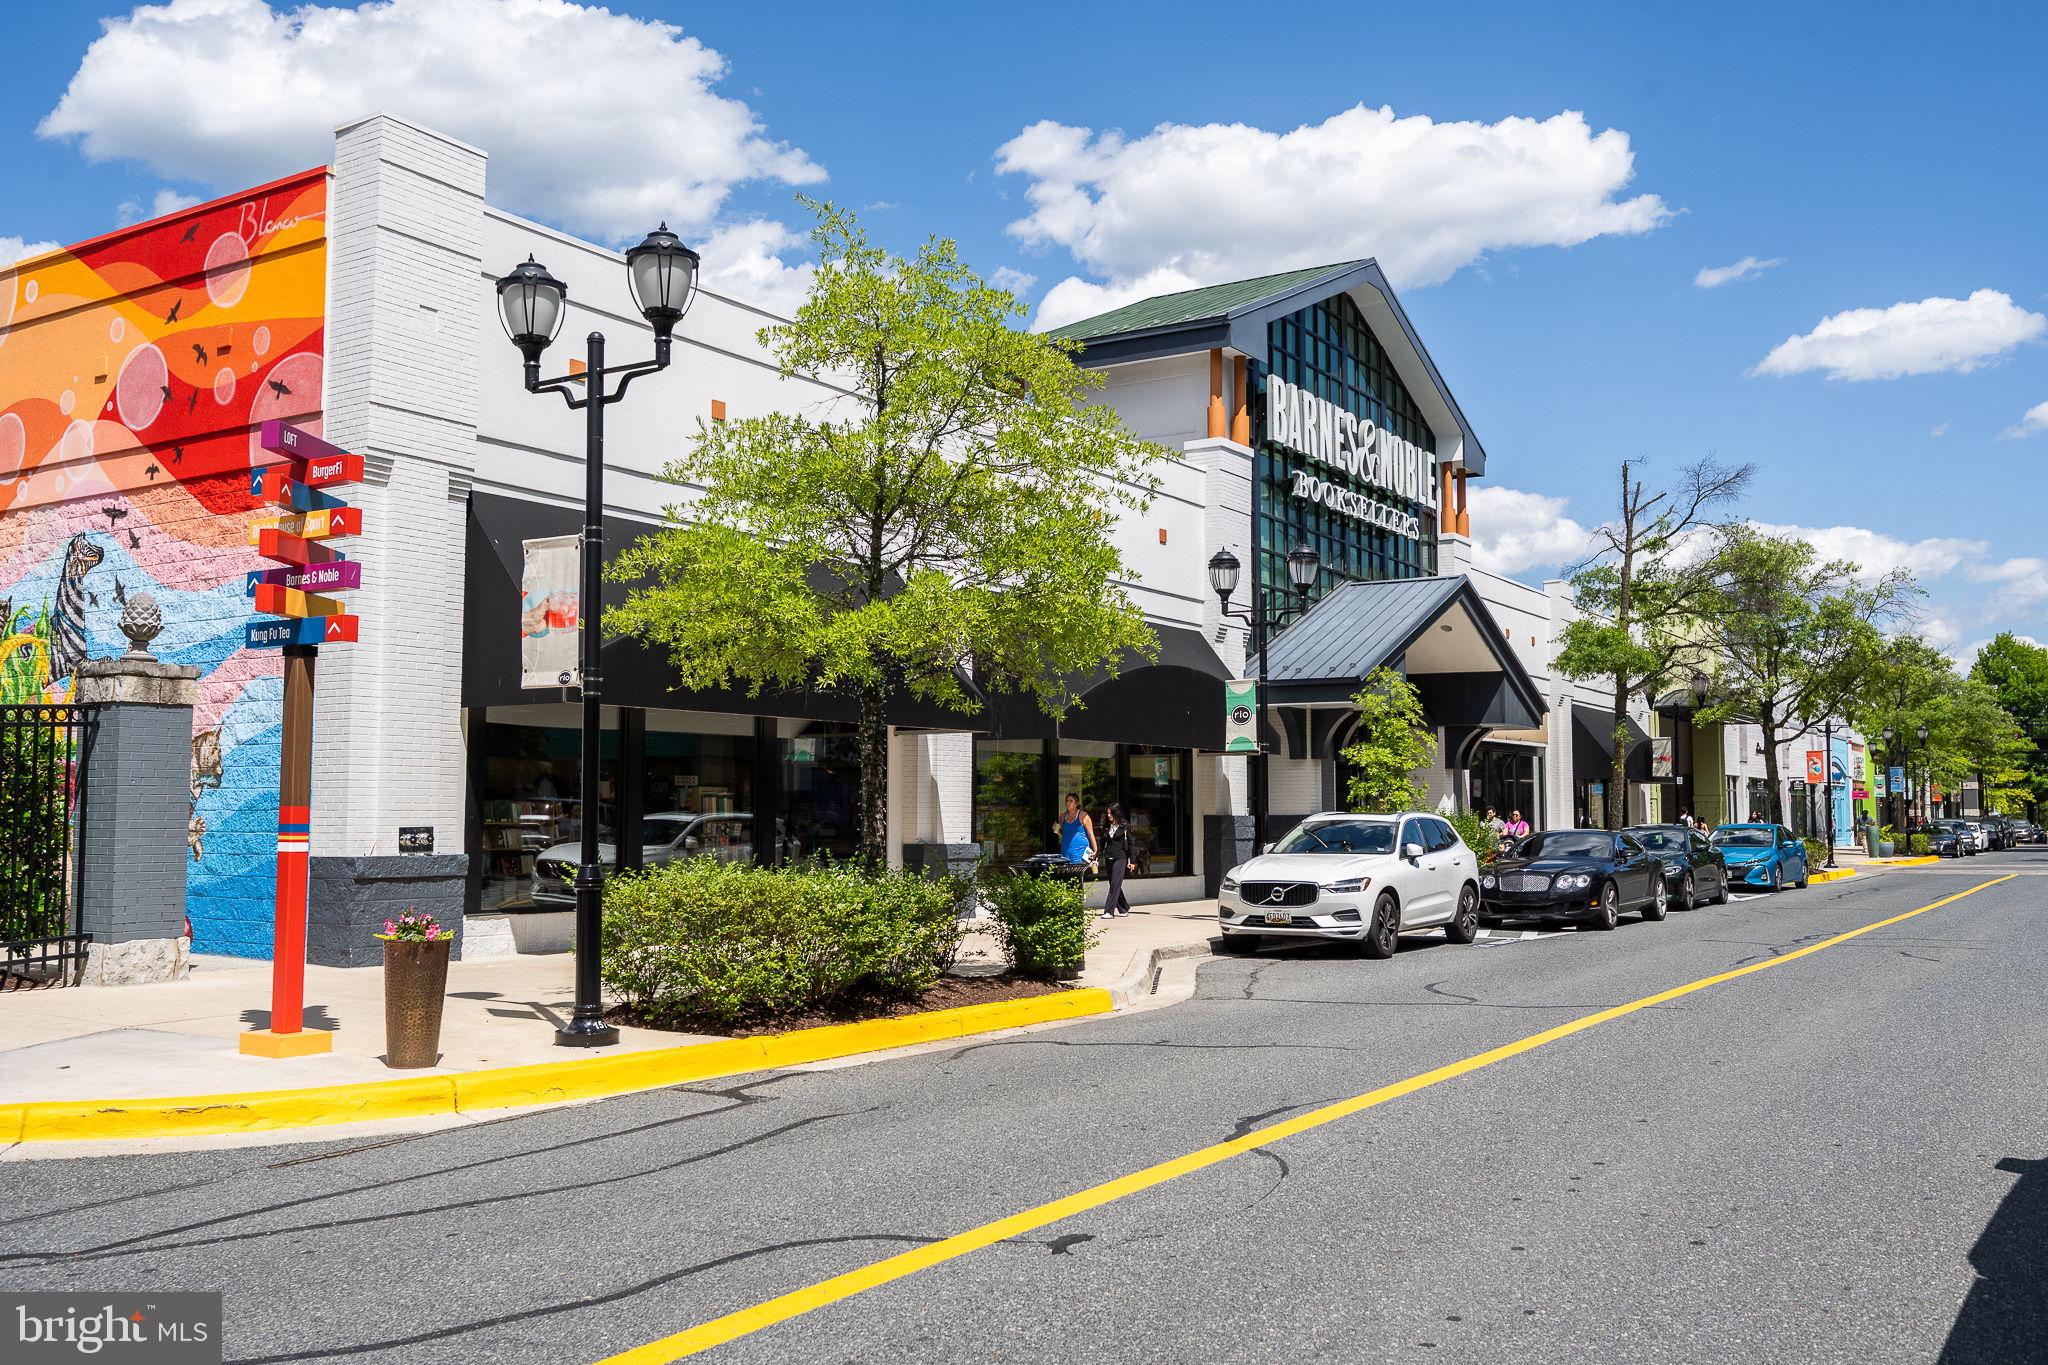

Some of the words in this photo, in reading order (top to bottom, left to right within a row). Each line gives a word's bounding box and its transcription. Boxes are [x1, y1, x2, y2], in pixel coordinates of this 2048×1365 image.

[283, 429, 298, 448] LOFT
[1266, 373, 1359, 476] BARNES
[1357, 418, 1381, 487] &
[1375, 427, 1437, 509] NOBLE
[312, 460, 343, 480] BurgerFi
[1291, 469, 1420, 541] BOOKSELLERS
[305, 515, 325, 534] Sport
[286, 572, 310, 587] Barnes
[311, 570, 317, 583] &
[318, 567, 340, 584] Noble
[251, 628, 268, 643] Kung
[269, 627, 277, 640] Fu
[279, 626, 291, 639] Tea
[1234, 710, 1249, 719] rio
